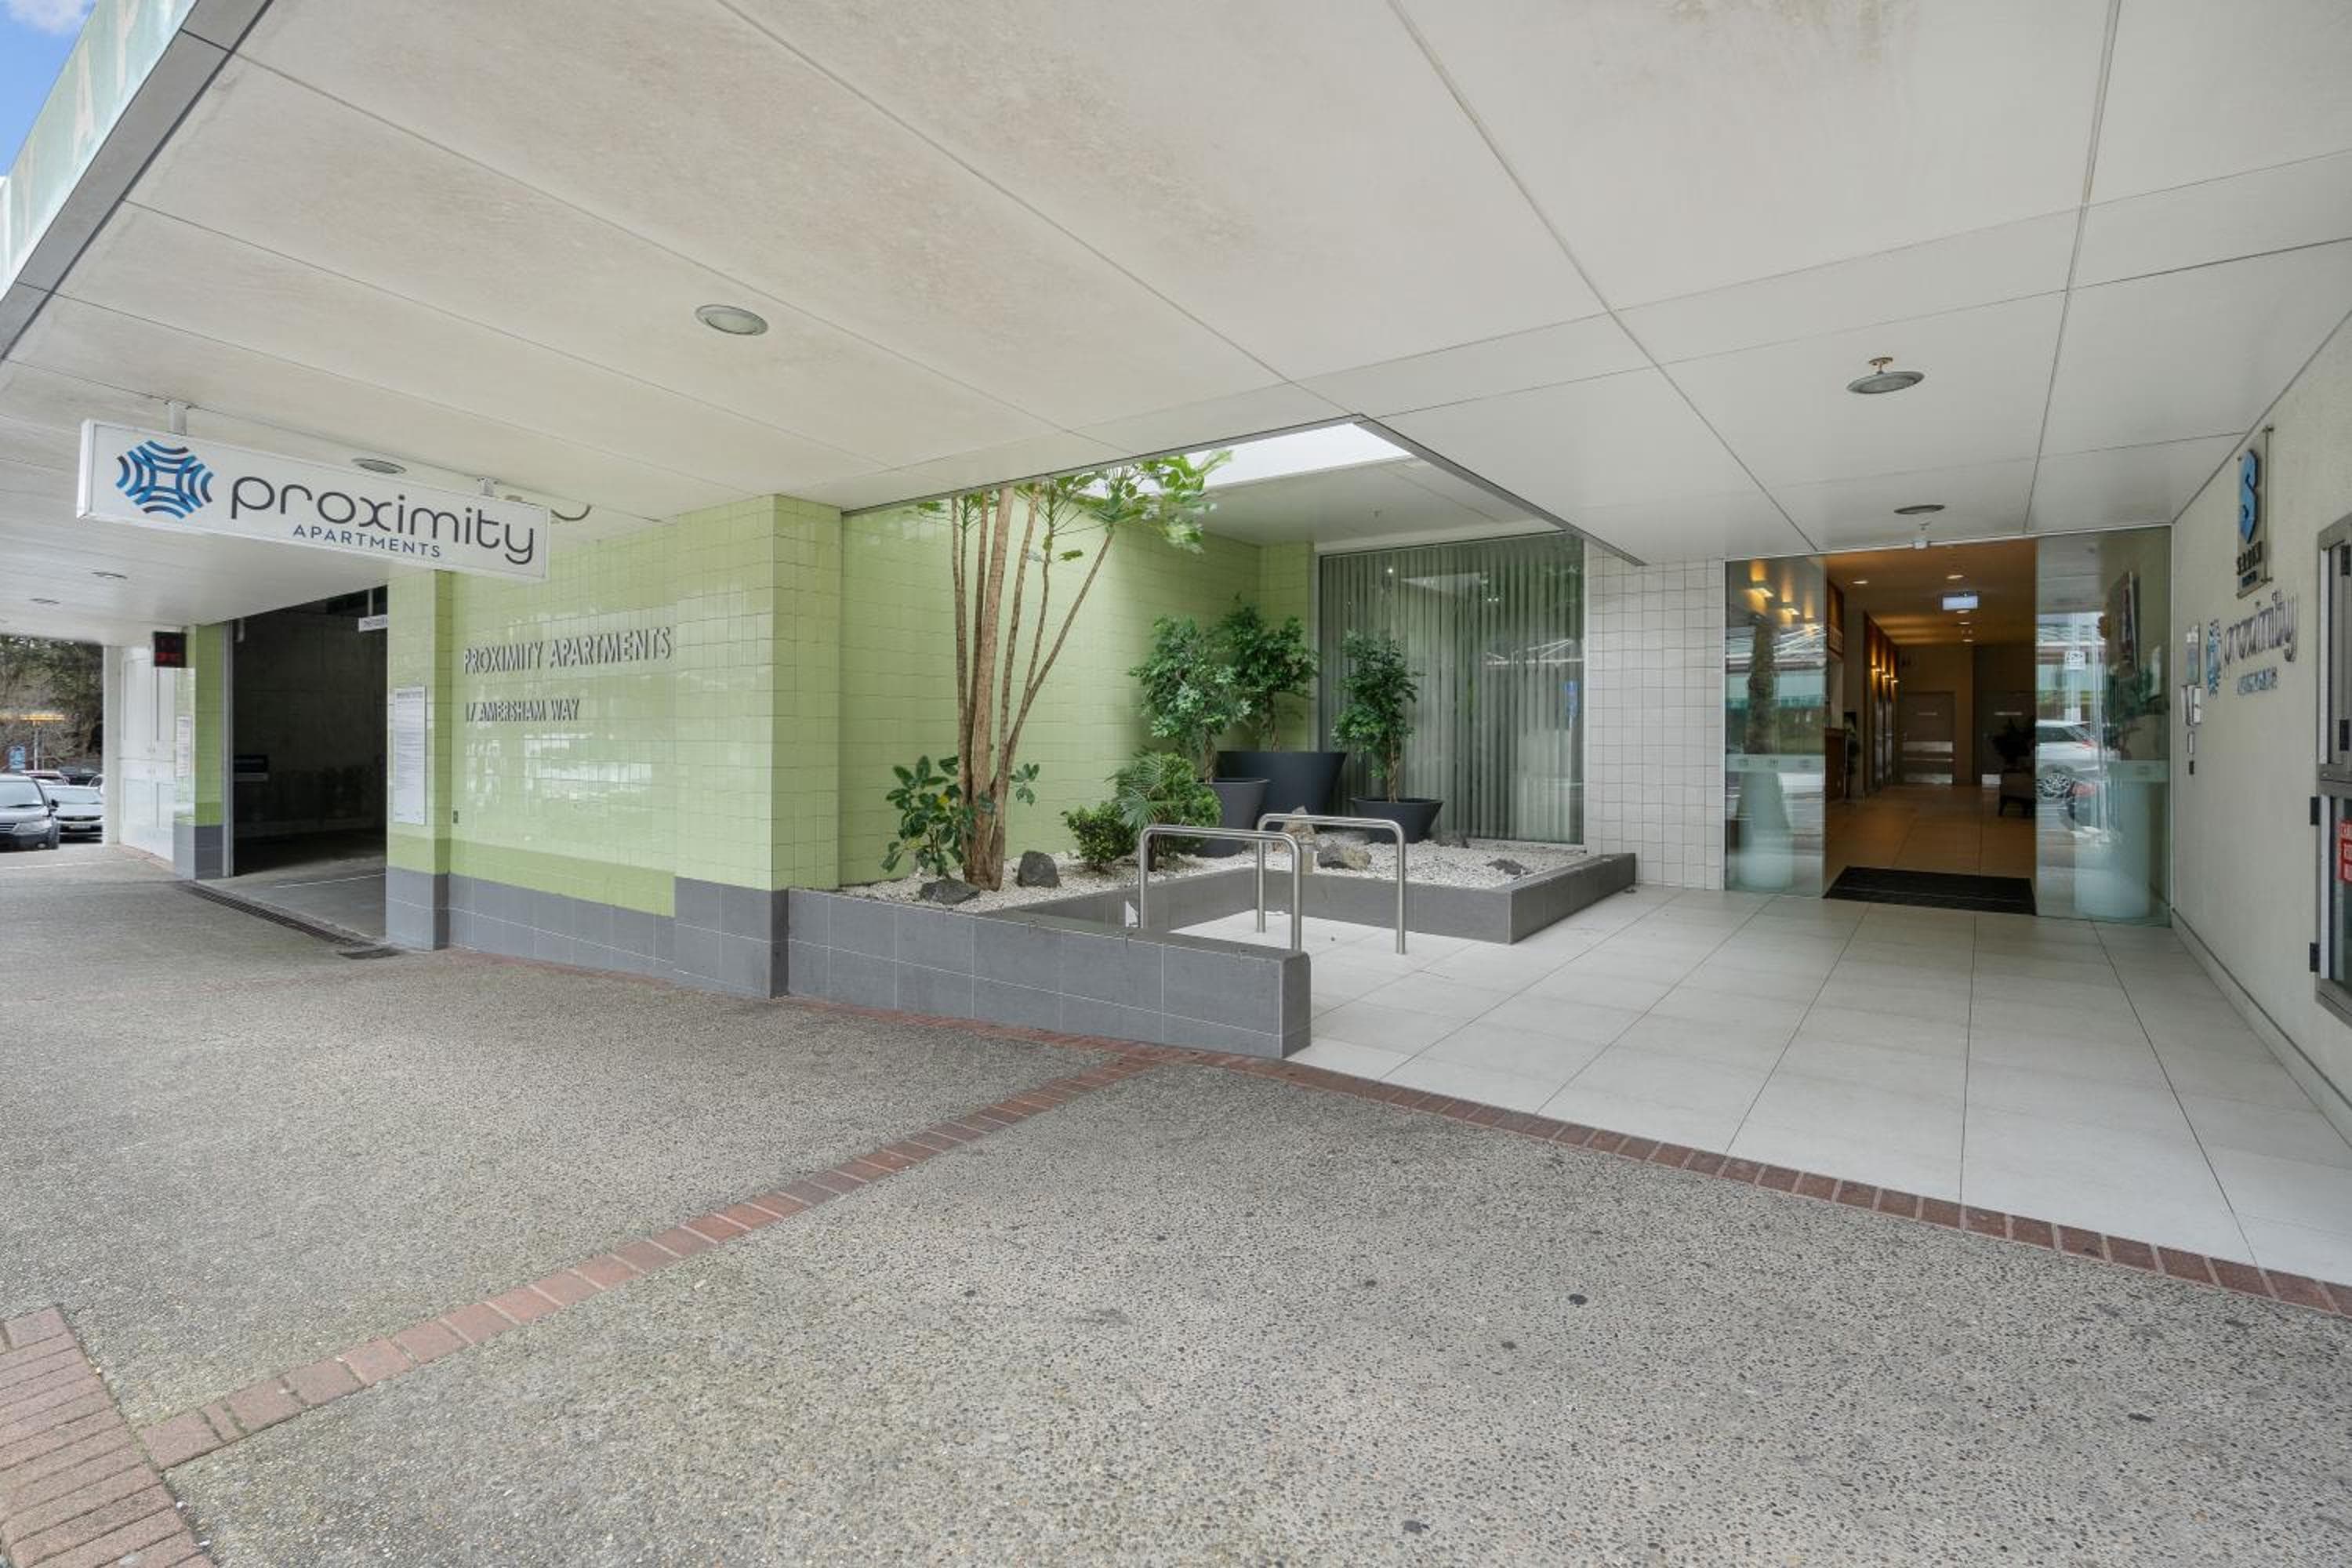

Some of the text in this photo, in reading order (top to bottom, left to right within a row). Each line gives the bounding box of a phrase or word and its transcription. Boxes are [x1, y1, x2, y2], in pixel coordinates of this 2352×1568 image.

[231, 476, 534, 565] proximity
[293, 524, 441, 558] APARTMENTS
[464, 626, 671, 674] PROXIMITY APARTMENTS
[477, 699, 547, 722] AMERSHAM
[550, 698, 580, 721] WAY
